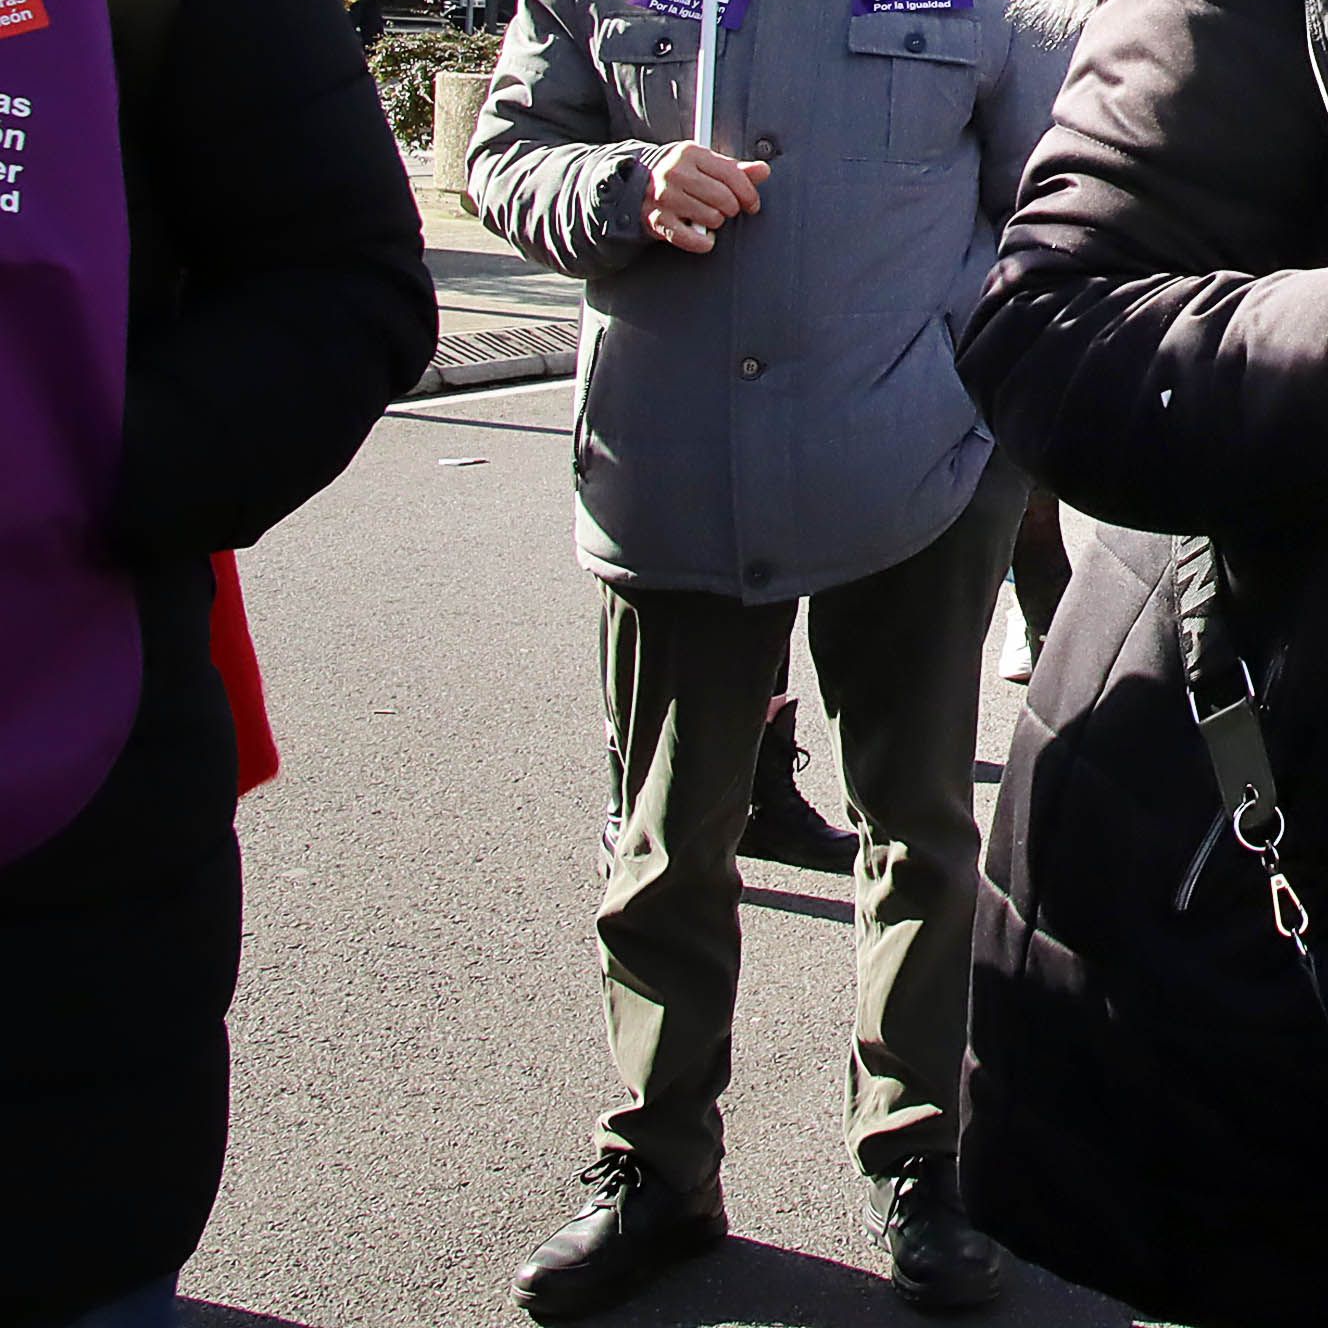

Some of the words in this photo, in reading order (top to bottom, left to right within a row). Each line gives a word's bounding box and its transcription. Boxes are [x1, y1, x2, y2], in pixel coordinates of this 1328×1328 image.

[649, 0, 667, 12] Por
[668, 3, 679, 16] la
[873, 3, 892, 12] Por
[894, 0, 905, 10] la
